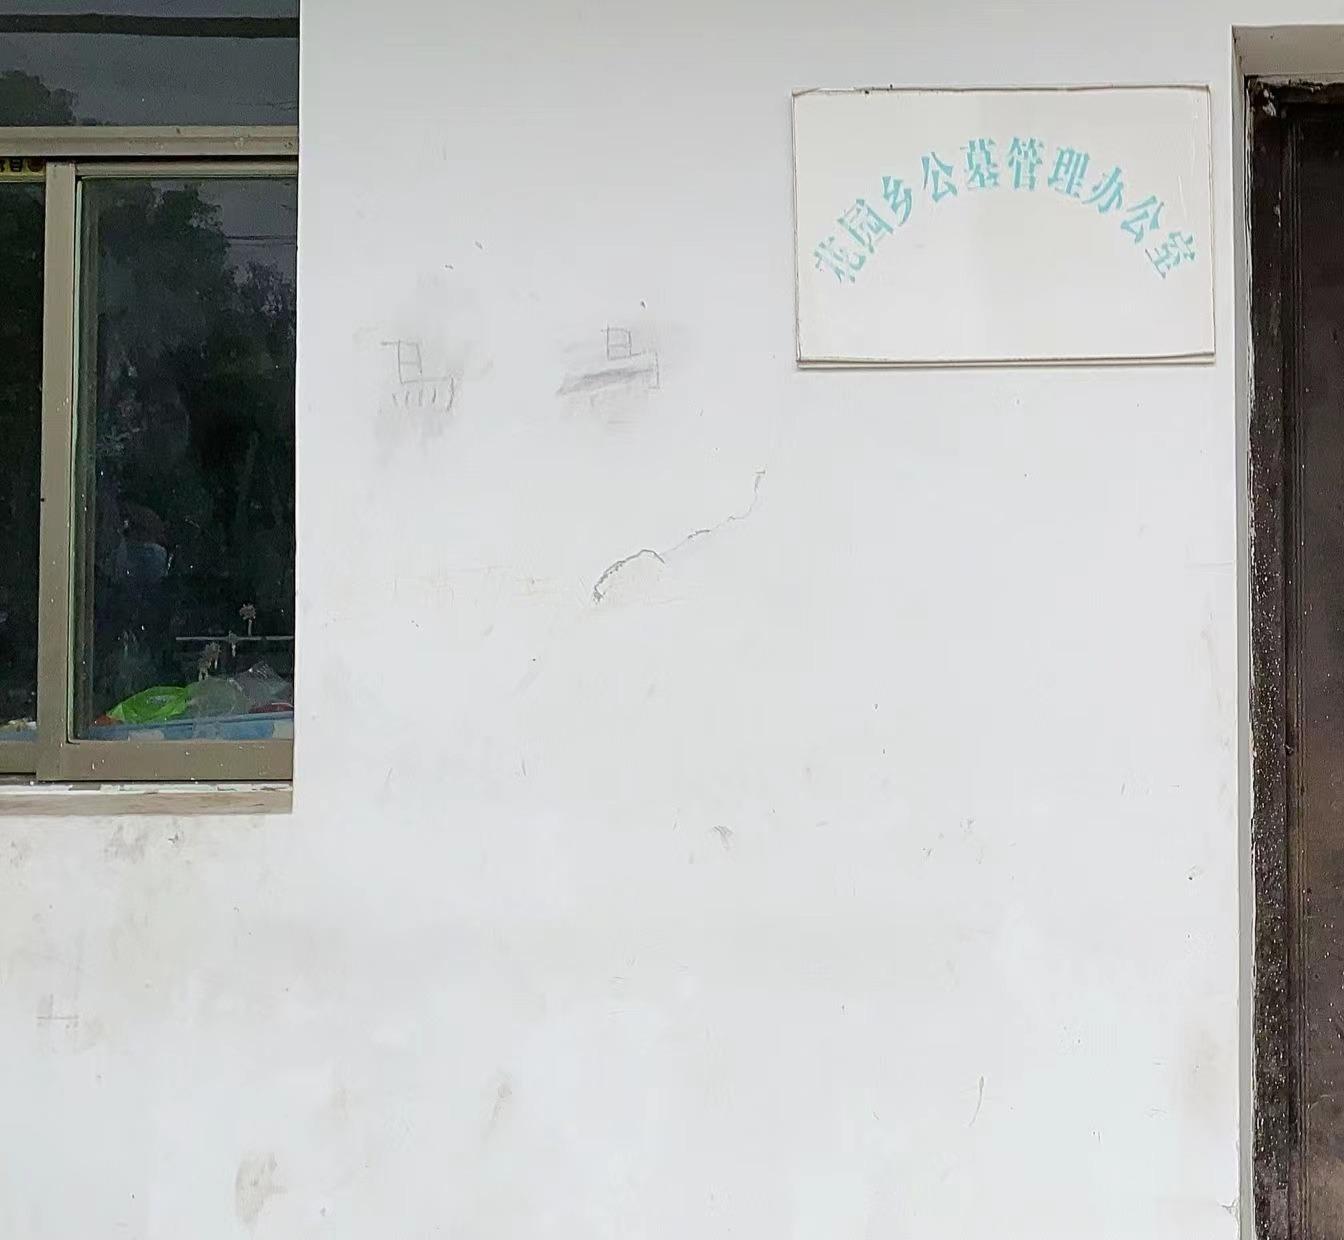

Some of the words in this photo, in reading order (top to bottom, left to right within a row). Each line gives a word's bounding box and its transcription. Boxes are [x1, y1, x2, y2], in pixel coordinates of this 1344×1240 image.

[813, 136, 1196, 283] 花园乡公墓管理办公室
